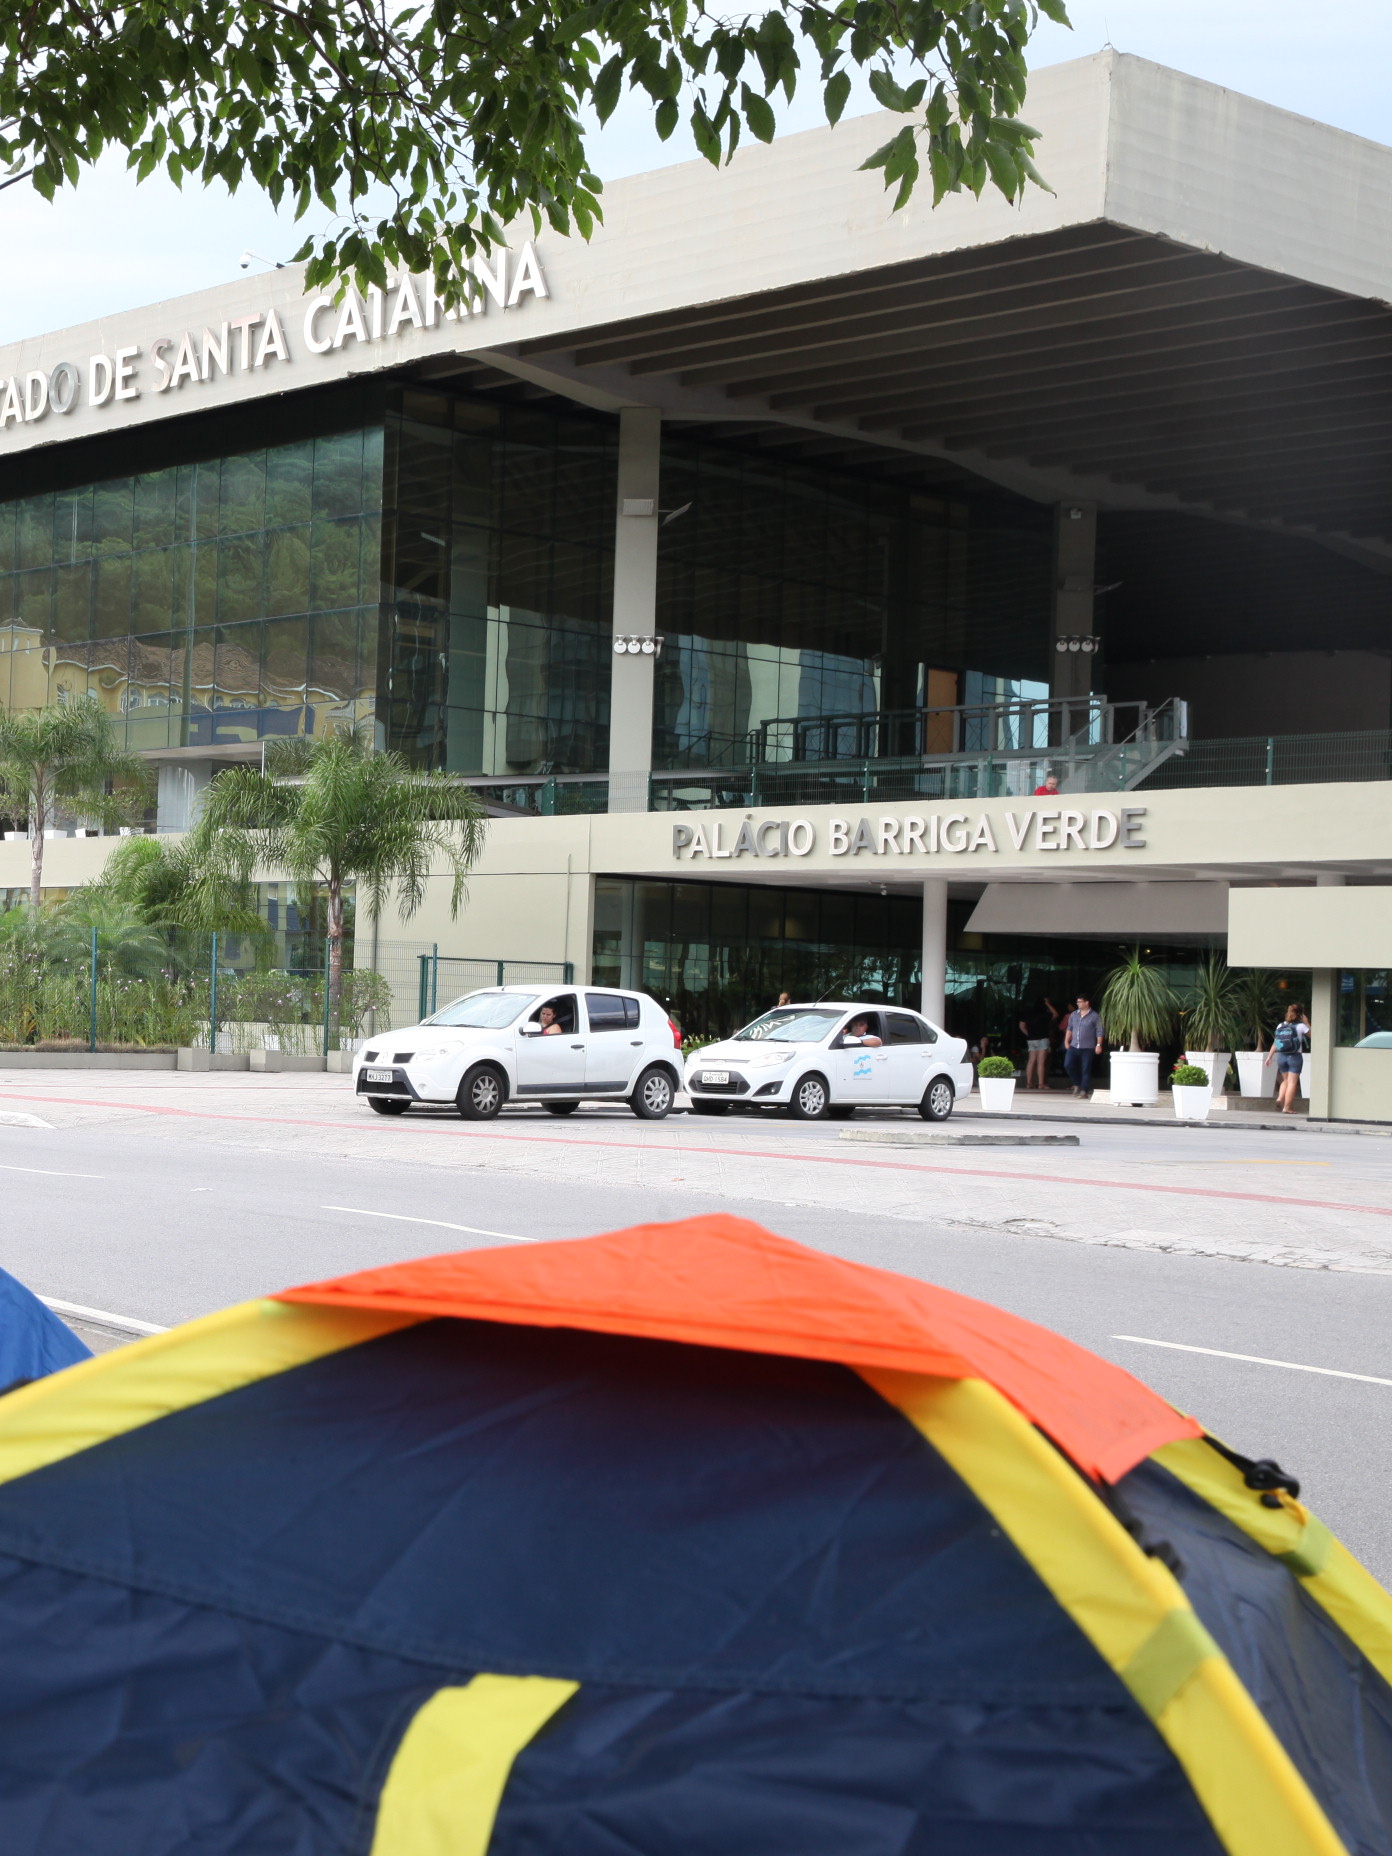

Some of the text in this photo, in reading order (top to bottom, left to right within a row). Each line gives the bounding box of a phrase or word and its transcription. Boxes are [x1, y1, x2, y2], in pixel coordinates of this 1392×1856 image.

[88, 345, 140, 407] DE
[151, 309, 289, 392] SANTA
[672, 808, 1147, 859] PALÁCIO BARRIGA VERDE
